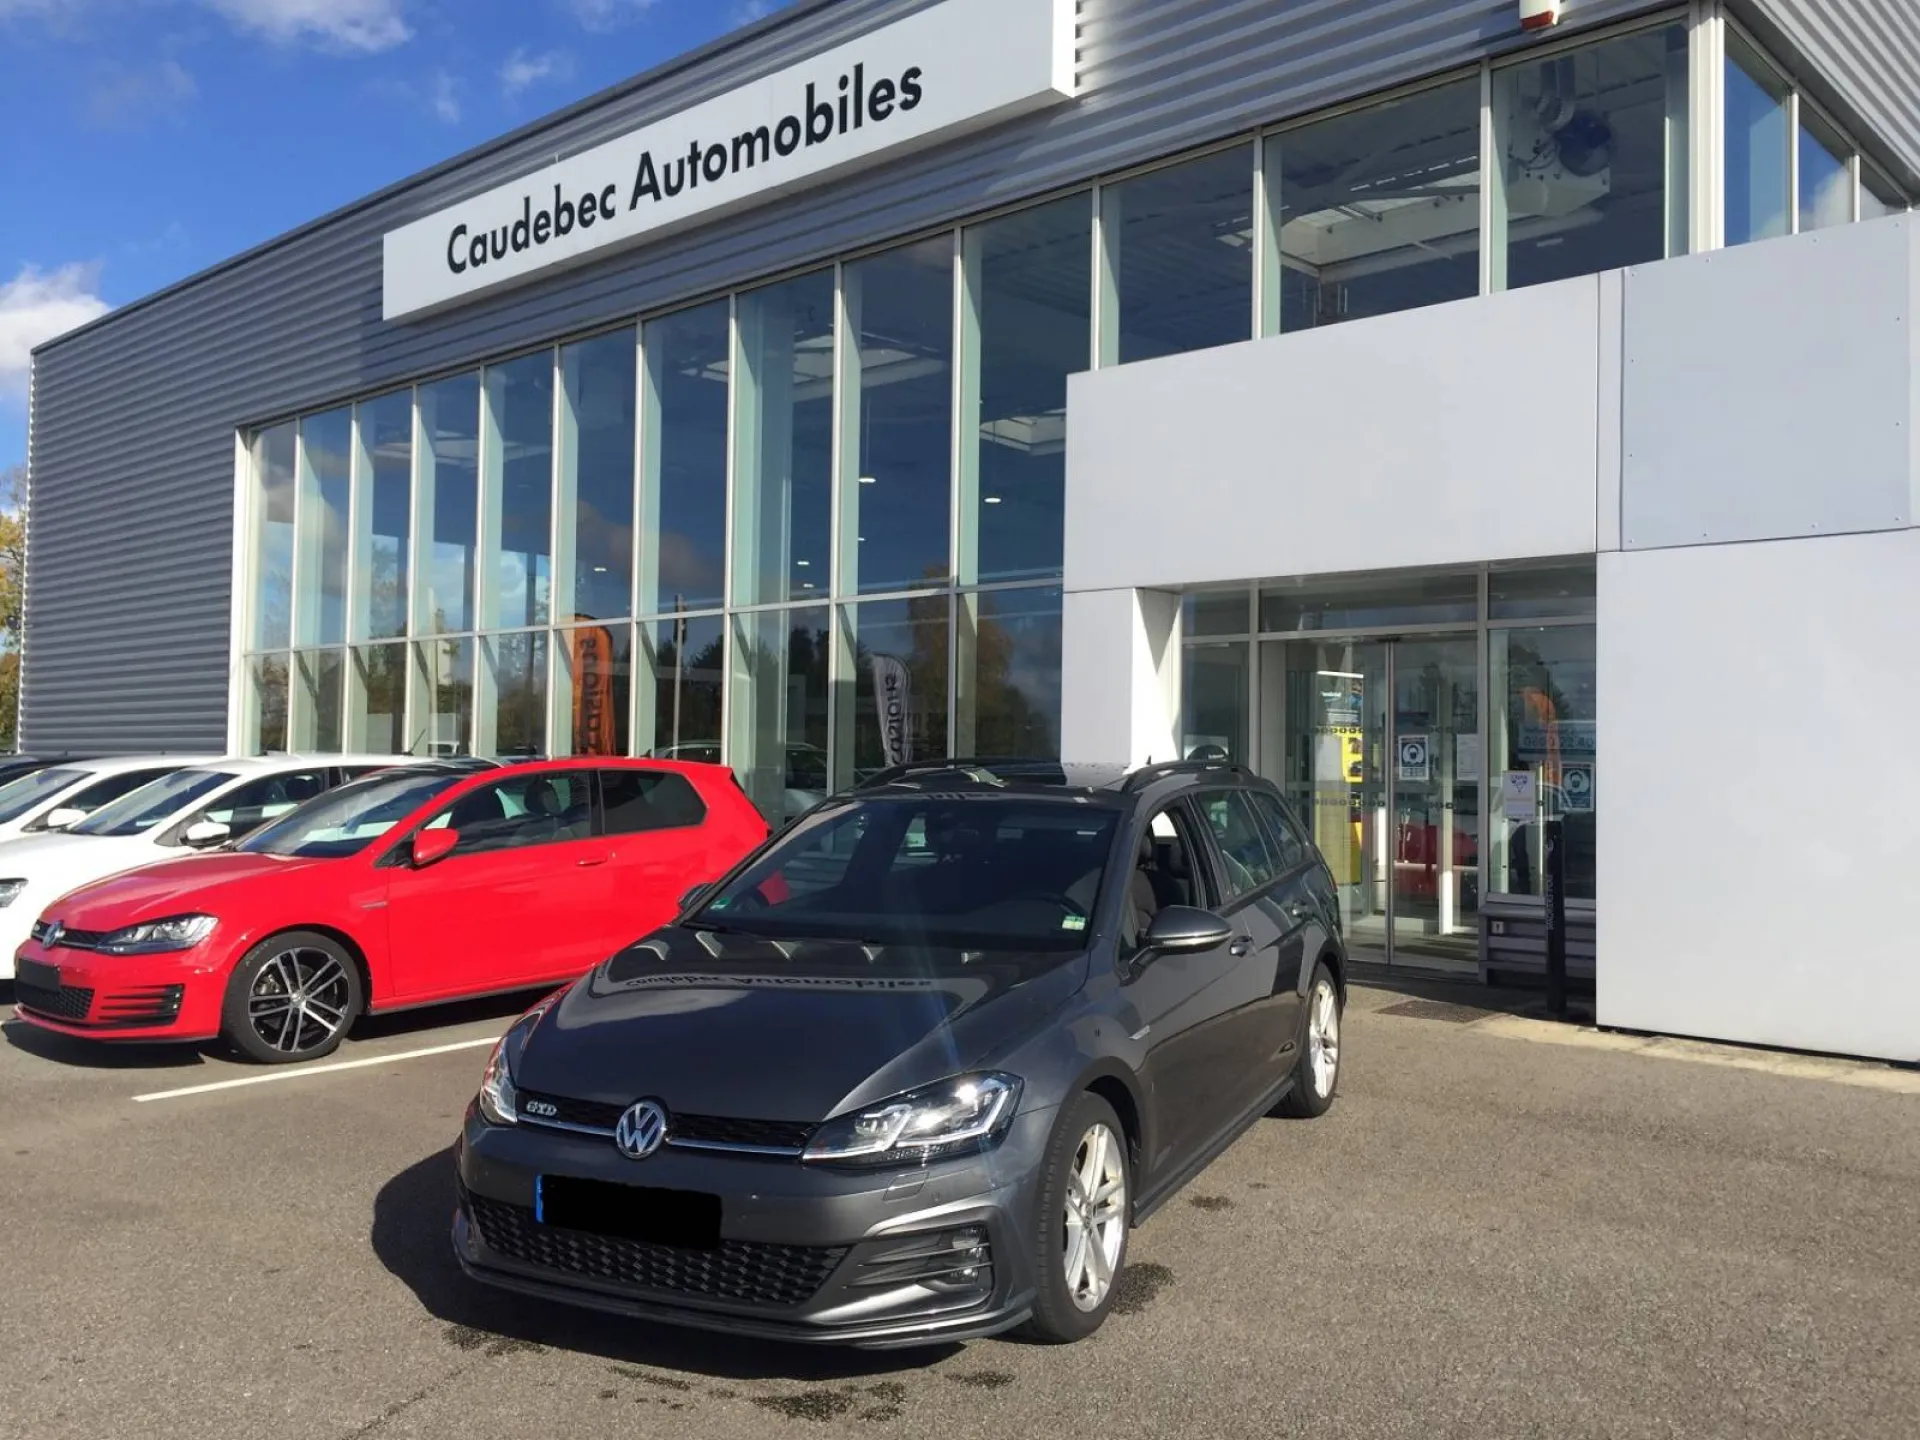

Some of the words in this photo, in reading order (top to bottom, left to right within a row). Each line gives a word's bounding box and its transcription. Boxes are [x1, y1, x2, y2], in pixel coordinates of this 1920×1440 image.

[447, 184, 616, 274] Caudebec
[629, 61, 923, 211] Automobiles
[526, 1100, 557, 1116] GTD
